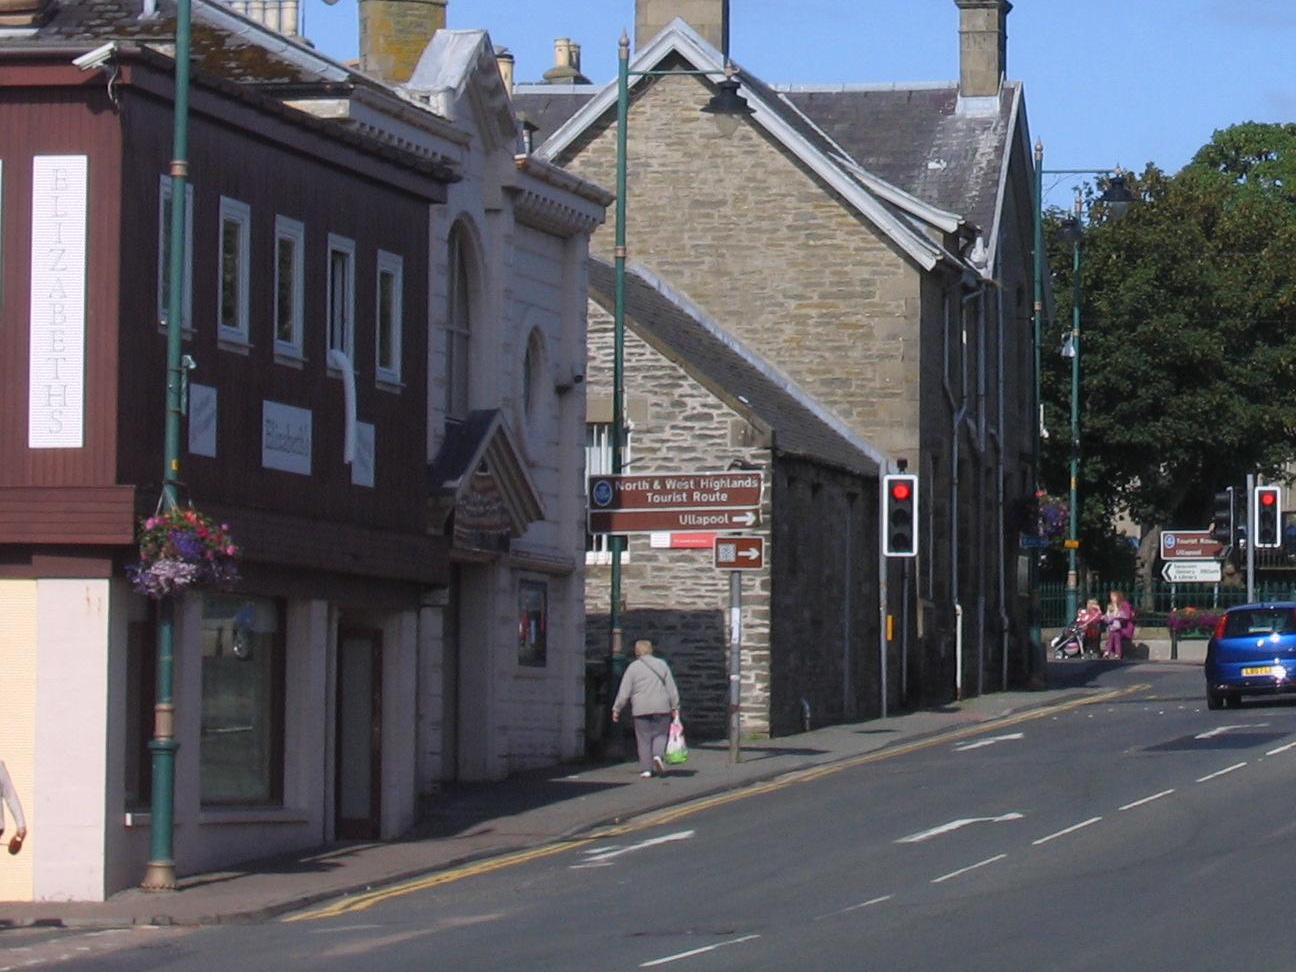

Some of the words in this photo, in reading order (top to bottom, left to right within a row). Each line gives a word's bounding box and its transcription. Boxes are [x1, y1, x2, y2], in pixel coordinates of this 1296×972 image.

[44, 167, 68, 435] ELIZABETHS
[615, 480, 649, 491] North
[653, 479, 661, 490] &
[665, 478, 695, 489] West
[700, 477, 759, 490] Highlands
[646, 492, 687, 503] Tourist
[693, 491, 728, 502] Route
[679, 514, 728, 526] Ullapool
